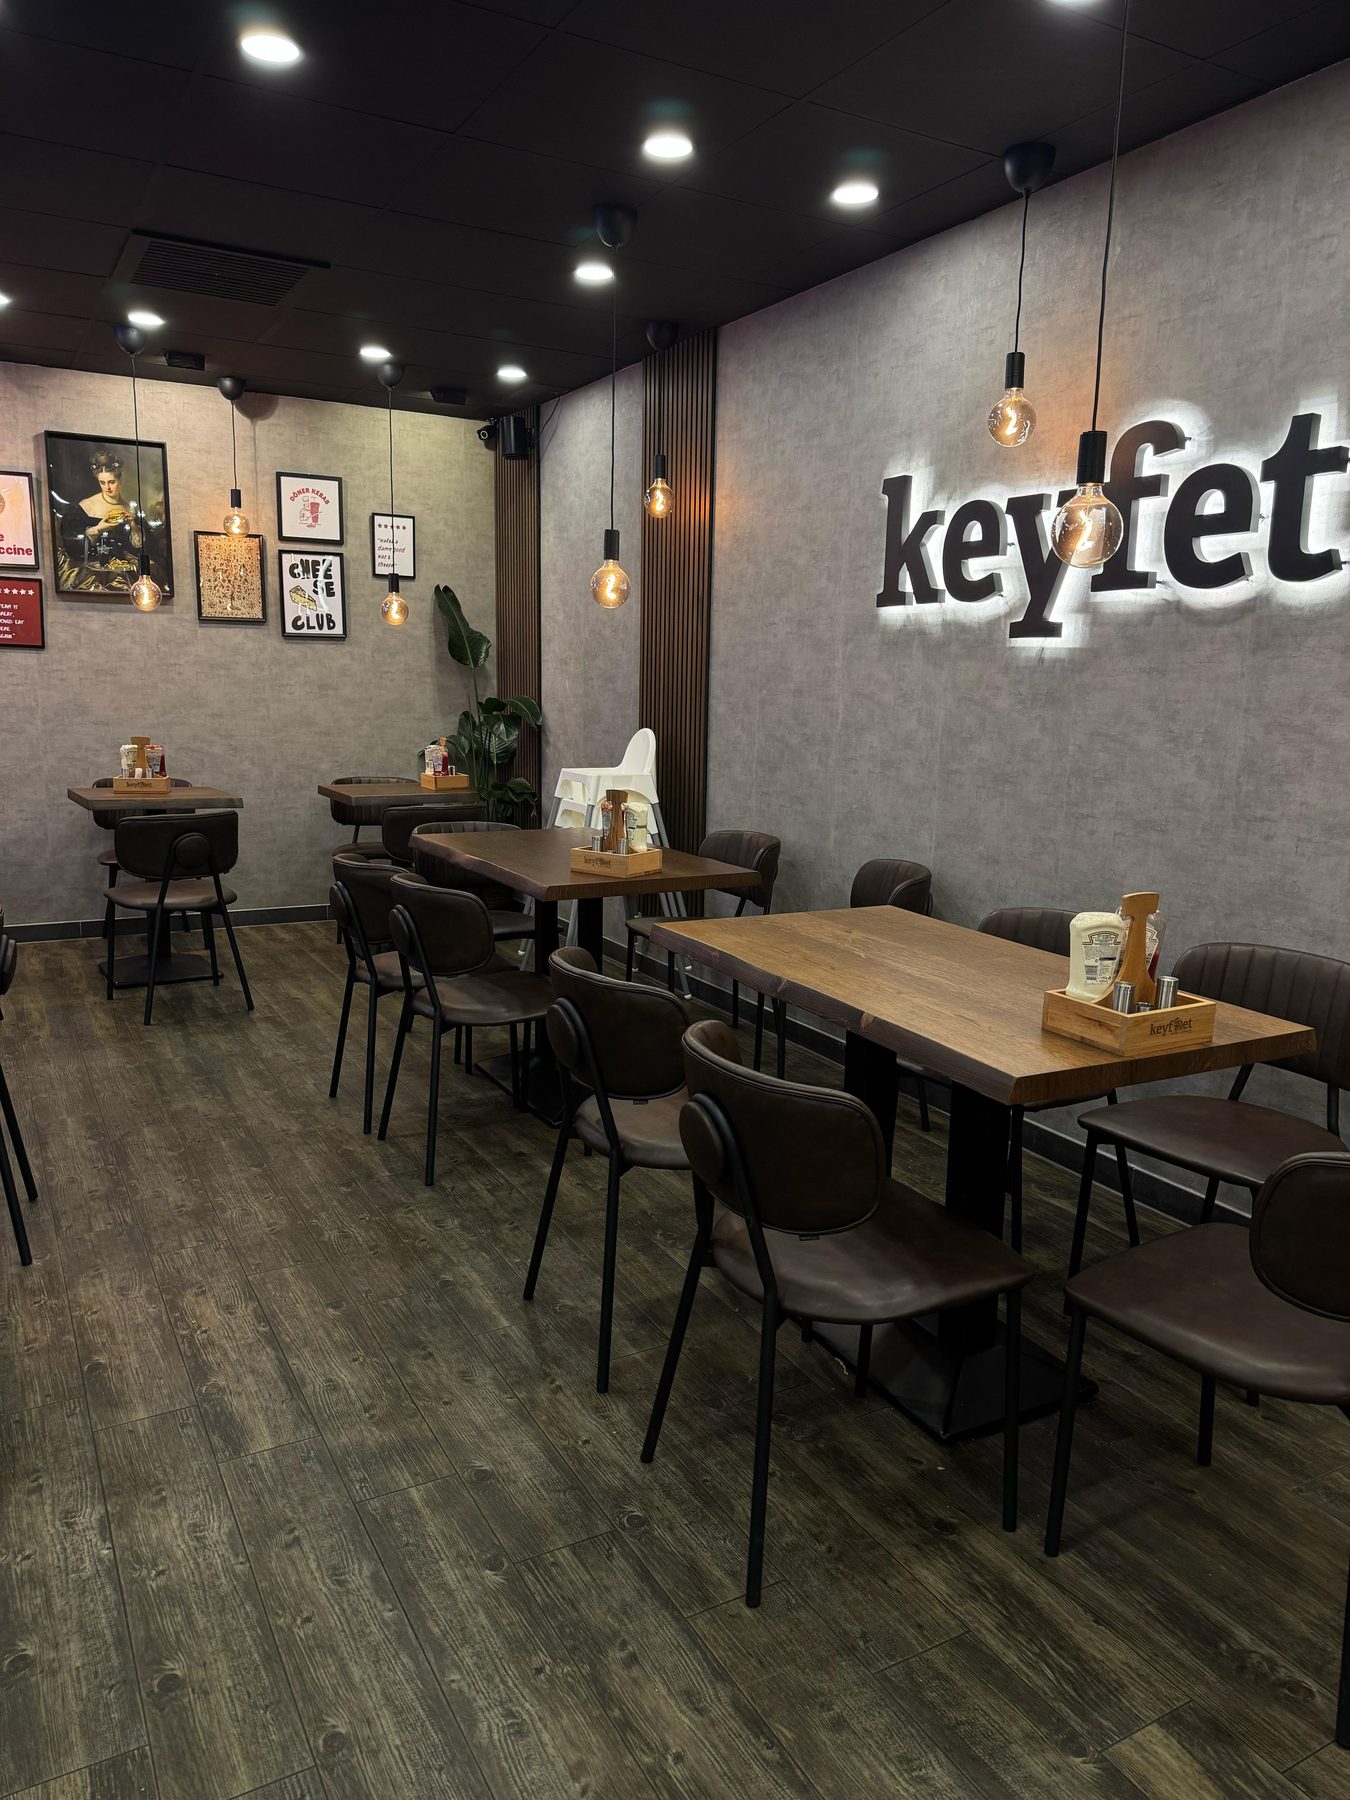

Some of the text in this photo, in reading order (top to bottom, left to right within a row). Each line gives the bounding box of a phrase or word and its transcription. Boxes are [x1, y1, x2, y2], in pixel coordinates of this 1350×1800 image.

[289, 488, 330, 505] DÖNER KEBAB
[876, 413, 1349, 638] keyfet
[289, 559, 332, 579] CHEE
[313, 580, 335, 597] SE
[292, 613, 336, 630] CLUB
